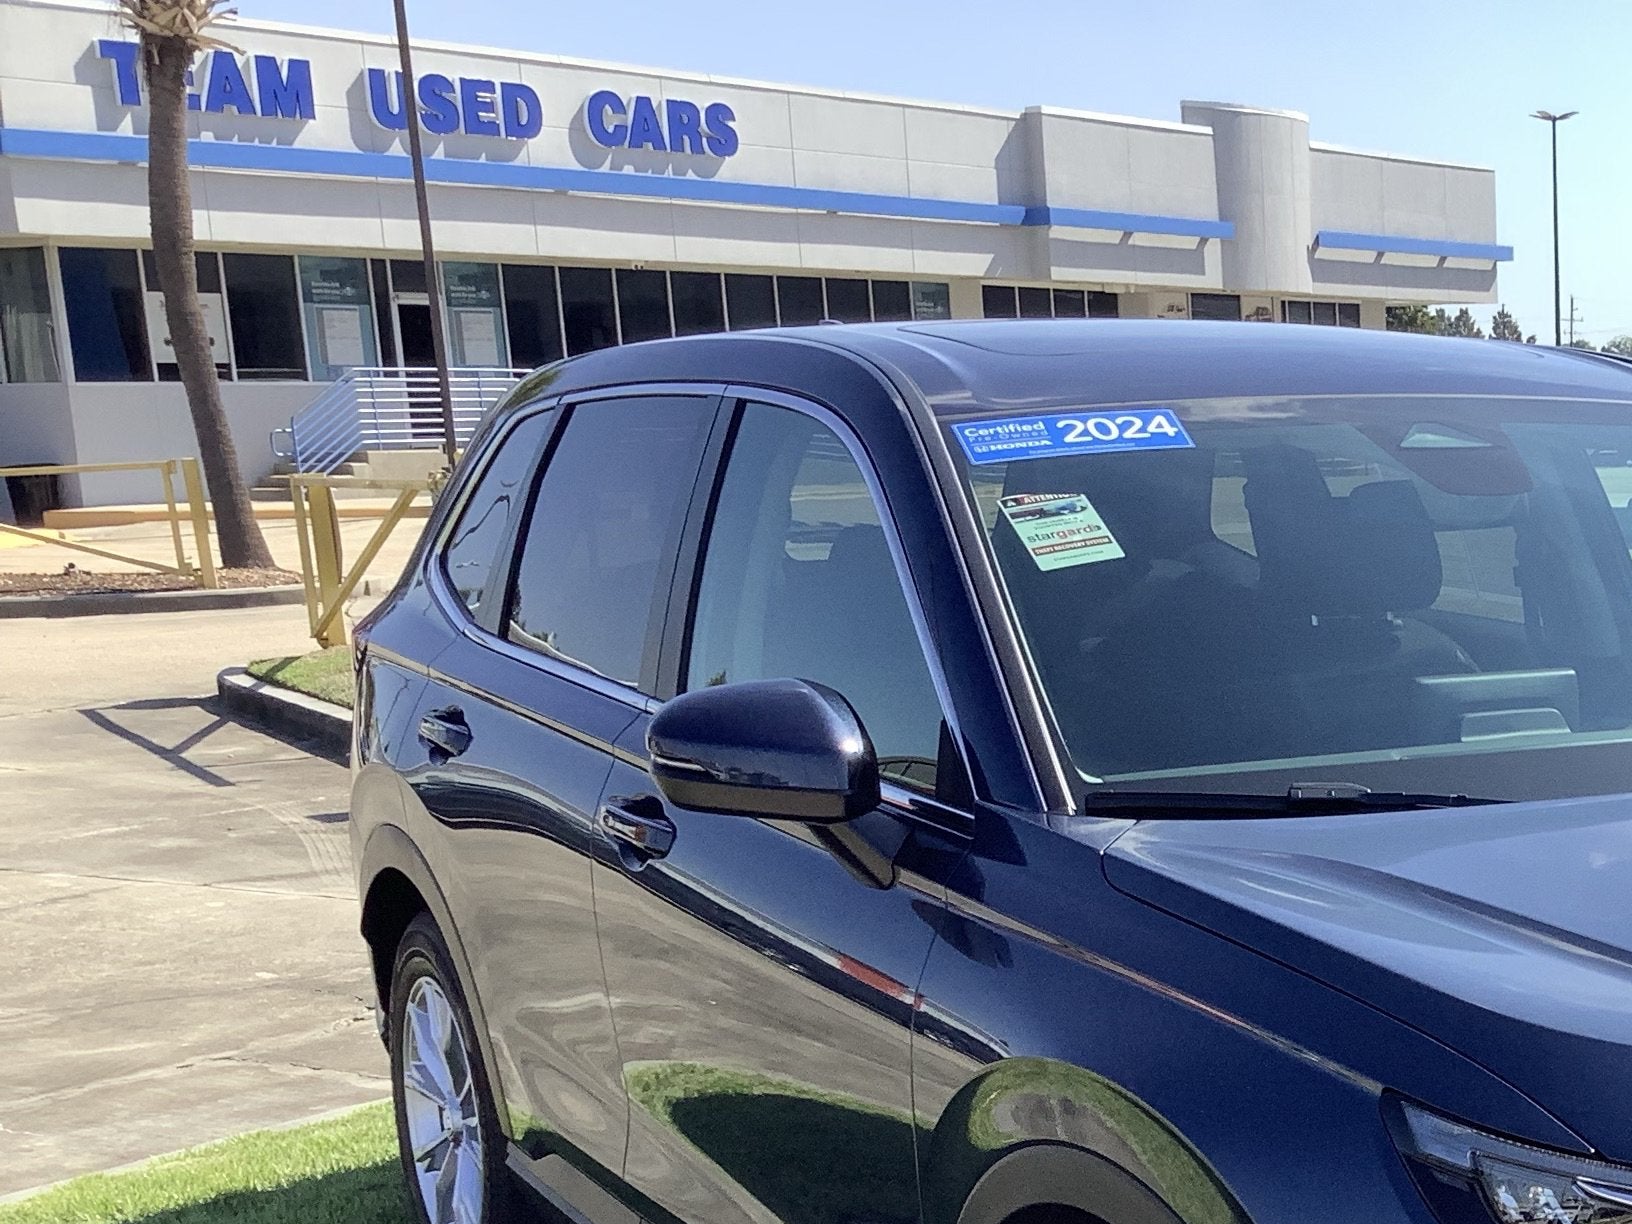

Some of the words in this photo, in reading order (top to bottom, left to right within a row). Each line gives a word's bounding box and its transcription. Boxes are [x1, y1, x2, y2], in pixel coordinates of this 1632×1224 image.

[367, 67, 543, 140] USED
[586, 89, 739, 158] CARS
[963, 421, 1046, 437] Certified
[968, 429, 1049, 443] Pre-Owned
[1056, 414, 1178, 443] 2024
[989, 440, 1054, 451] HONDA
[1023, 493, 1078, 504] ATTENTI
